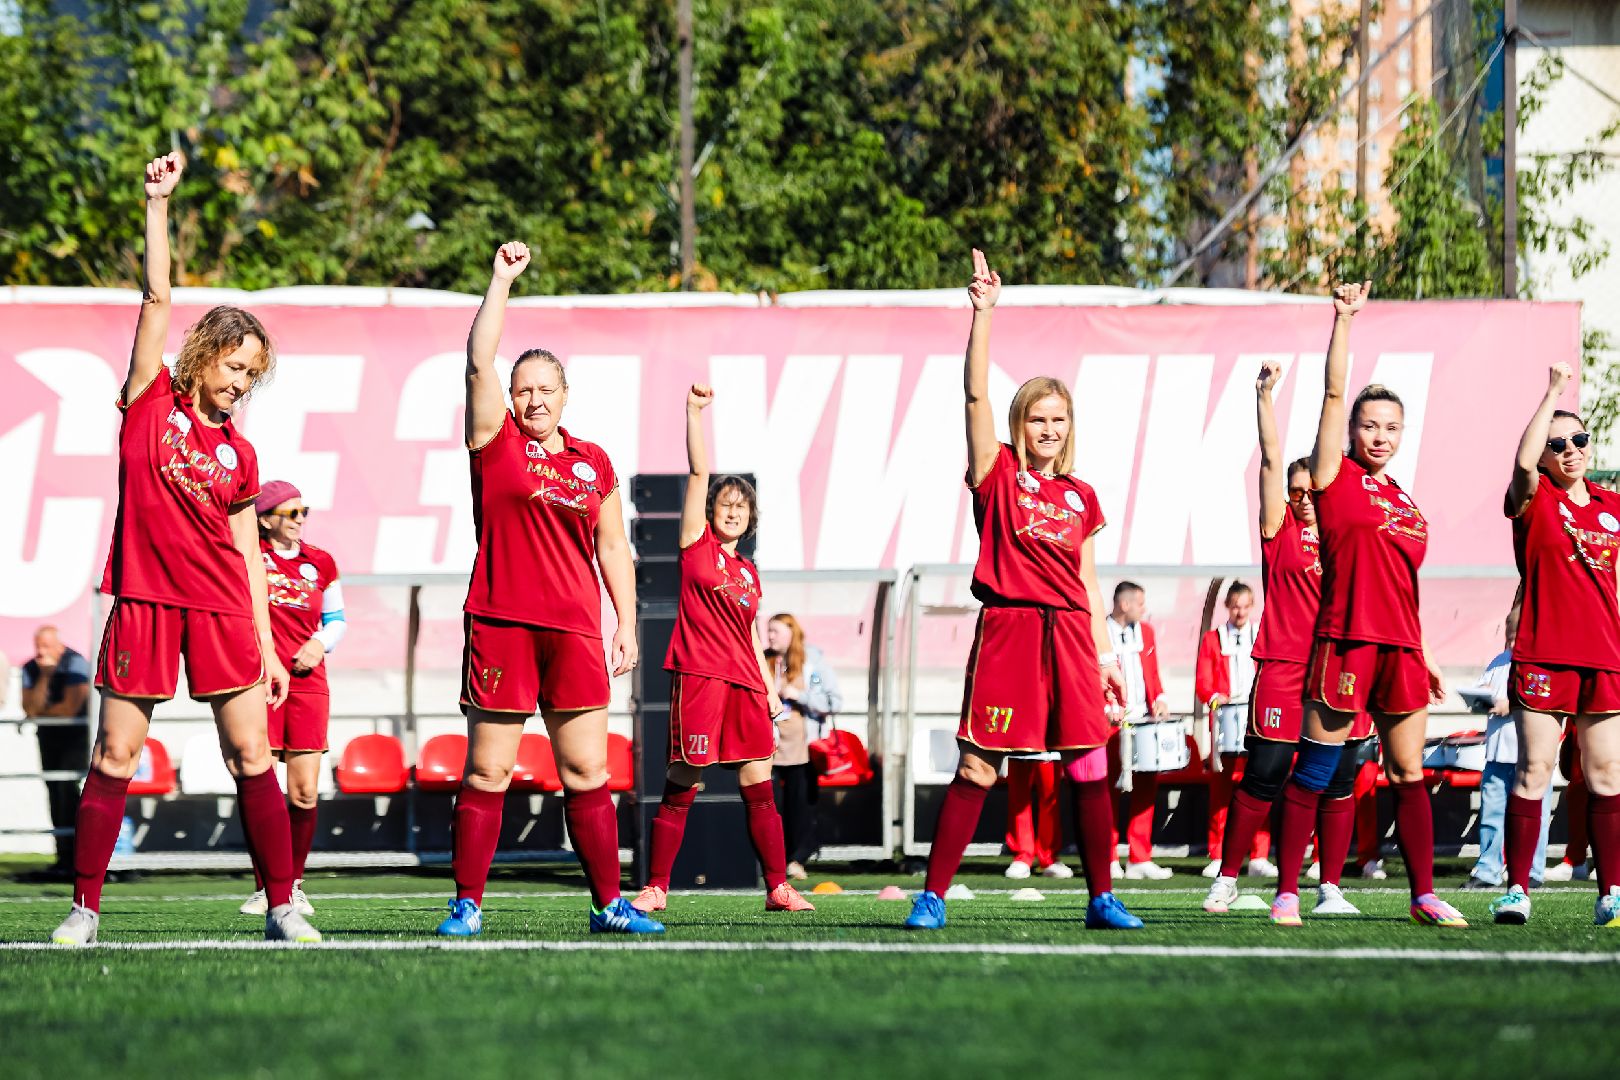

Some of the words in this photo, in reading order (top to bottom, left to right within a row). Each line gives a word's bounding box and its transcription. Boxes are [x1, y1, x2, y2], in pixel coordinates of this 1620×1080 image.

[116, 650, 131, 678] 8
[482, 666, 503, 694] 17
[984, 705, 1014, 734] 37
[1263, 707, 1282, 729] 16
[687, 734, 709, 755] 20
